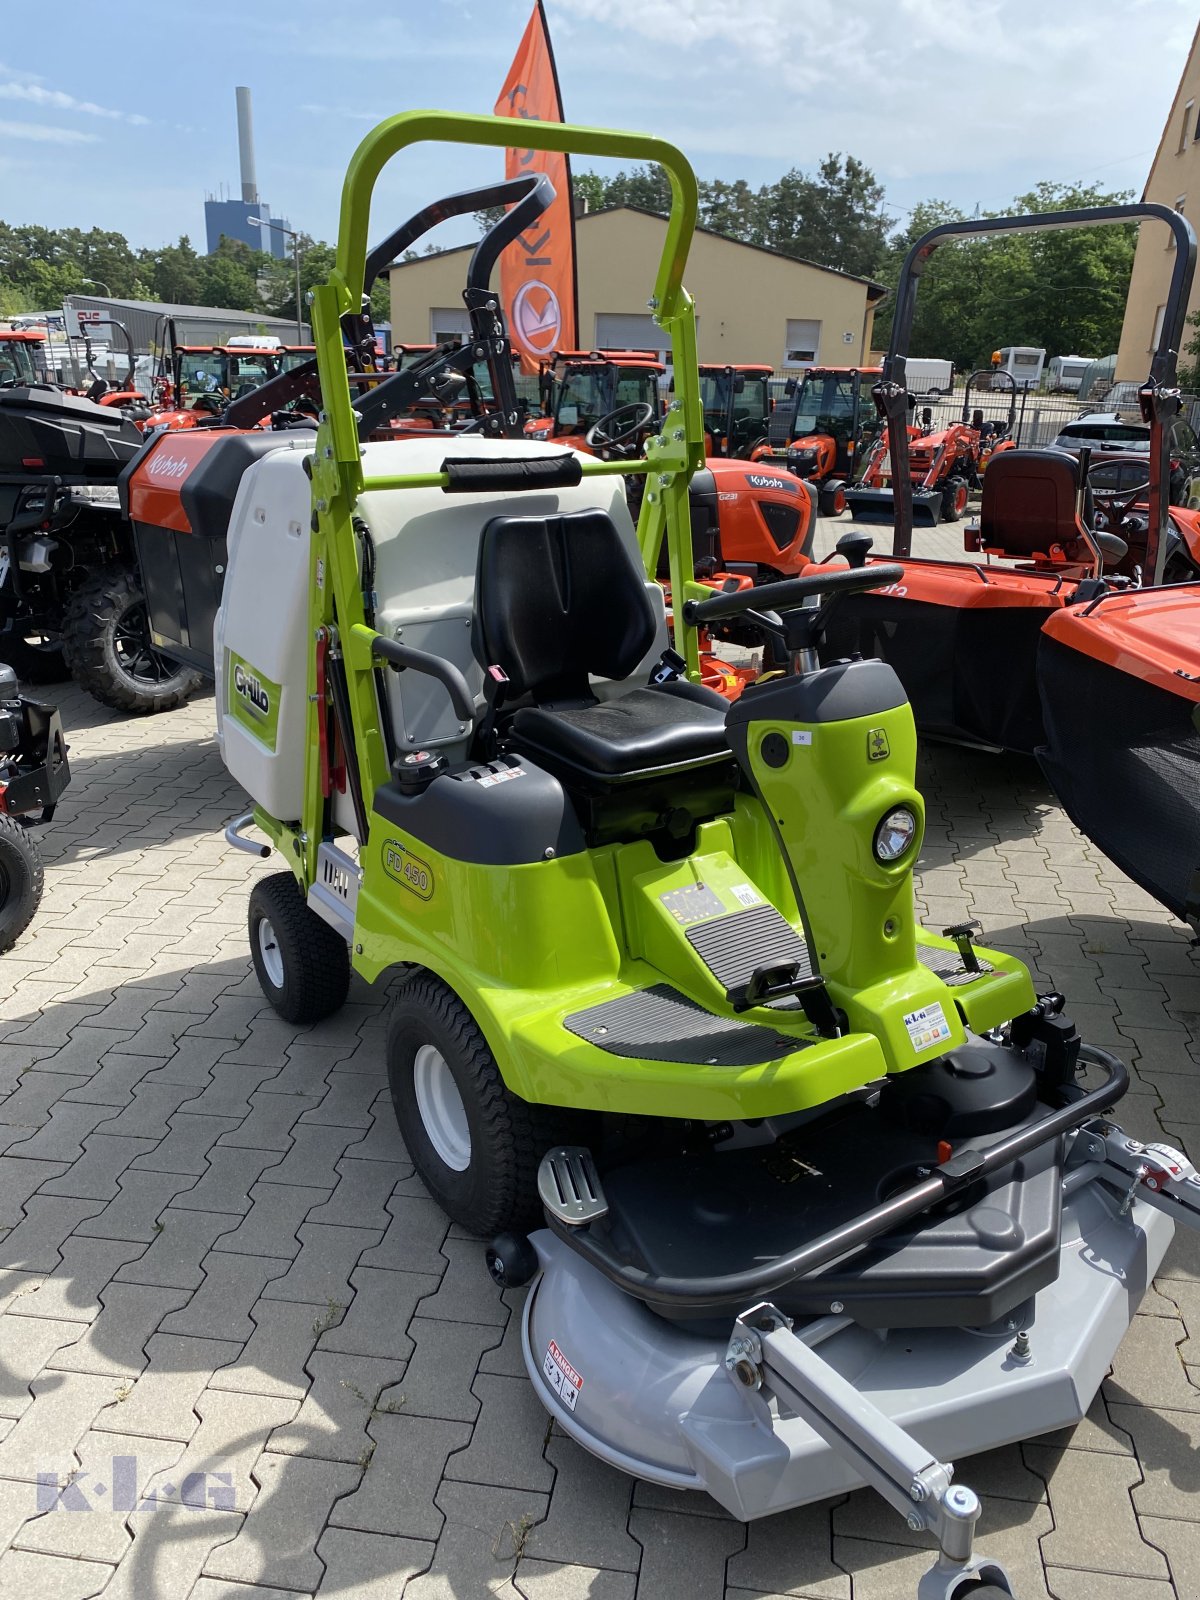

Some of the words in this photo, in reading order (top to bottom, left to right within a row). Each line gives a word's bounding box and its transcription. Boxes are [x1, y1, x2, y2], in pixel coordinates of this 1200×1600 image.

[149, 454, 188, 478] Kubota
[751, 475, 783, 488] Kubota
[235, 664, 269, 715] Grillo
[387, 848, 402, 872] FD
[404, 863, 427, 890] 450
[553, 1349, 580, 1386] DANGER
